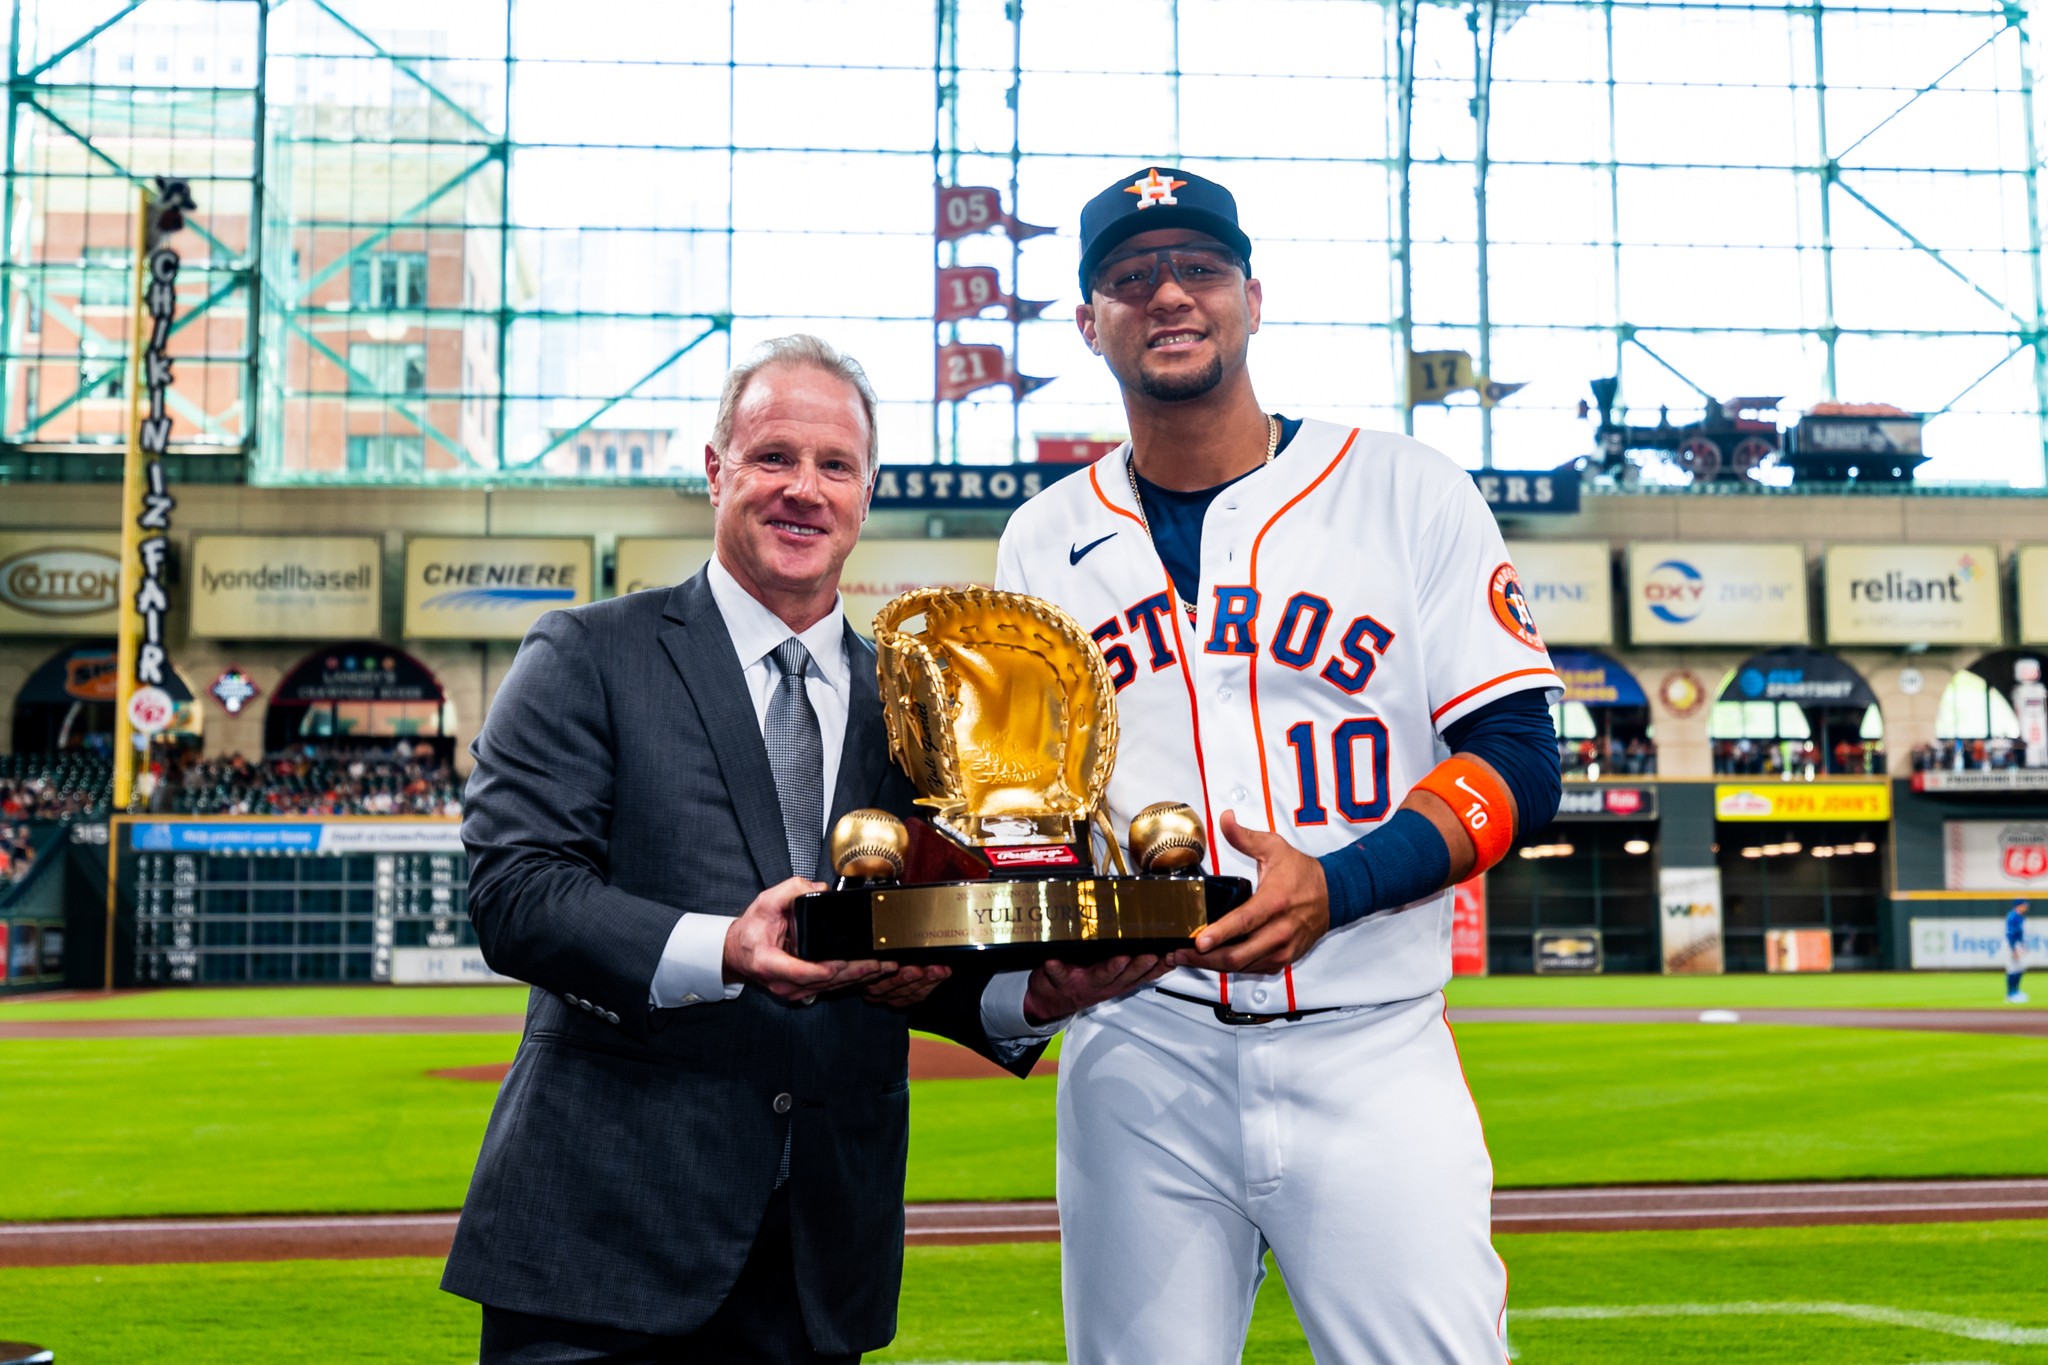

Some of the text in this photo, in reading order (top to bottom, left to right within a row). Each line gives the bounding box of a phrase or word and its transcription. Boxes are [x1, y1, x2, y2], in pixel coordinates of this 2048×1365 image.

[1135, 176, 1177, 210] H
[947, 194, 989, 227] 05
[951, 276, 990, 307] 19
[144, 254, 177, 452] CHIKIN
[948, 352, 985, 384] 21
[1423, 359, 1458, 390] 17
[141, 463, 172, 527] IZ
[877, 472, 1042, 498] ASTROS
[8, 563, 119, 603] COTTON
[202, 564, 371, 593] lyondellbasell
[423, 563, 577, 586] CHENIERE
[1850, 569, 1961, 602] reliant
[1523, 583, 1588, 602] LPINE
[1644, 584, 1703, 600] OXY
[138, 538, 168, 684] FAIR
[1090, 584, 1395, 695] STROS
[1287, 716, 1391, 827] 10
[1464, 801, 1489, 831] 10
[1775, 794, 1818, 814] PAPA
[2009, 852, 2043, 872] 66
[974, 906, 1022, 925] YULI
